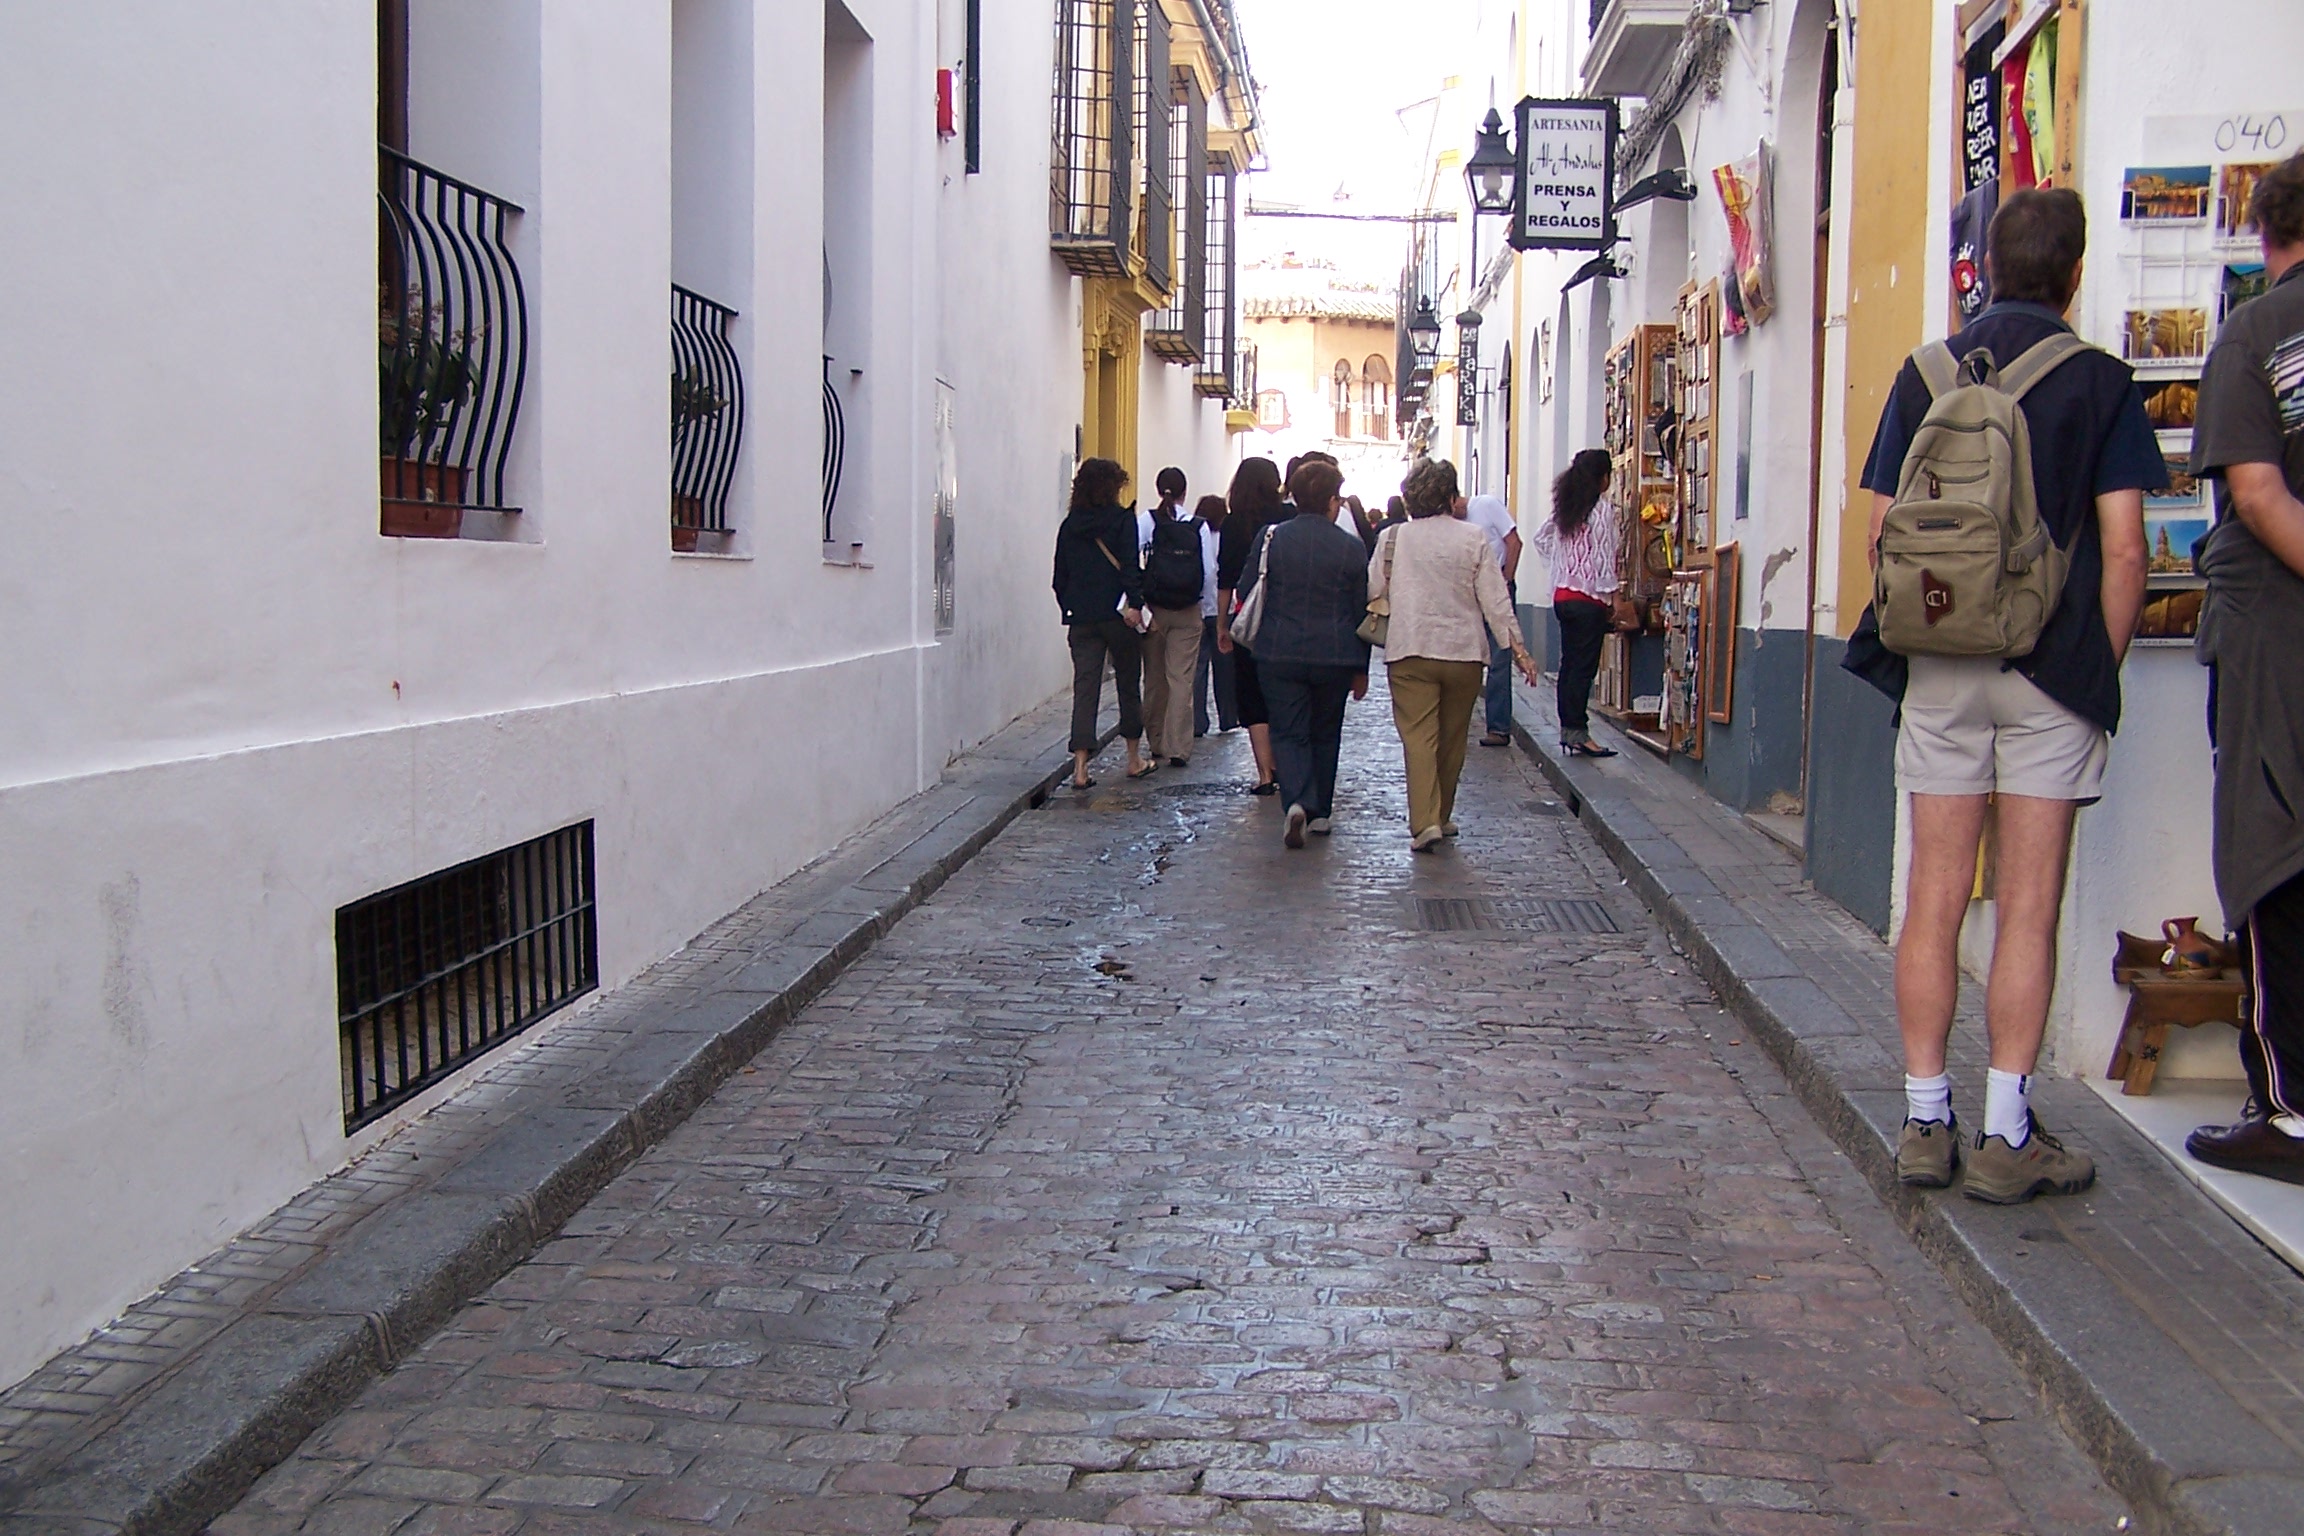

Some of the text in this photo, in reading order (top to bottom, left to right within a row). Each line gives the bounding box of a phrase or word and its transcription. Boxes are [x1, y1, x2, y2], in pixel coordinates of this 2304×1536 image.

[1531, 118, 1603, 131] ARTESANIA
[1534, 184, 1596, 198] PRENSA
[1560, 200, 1571, 212] Y
[1528, 215, 1601, 229] REGALOS
